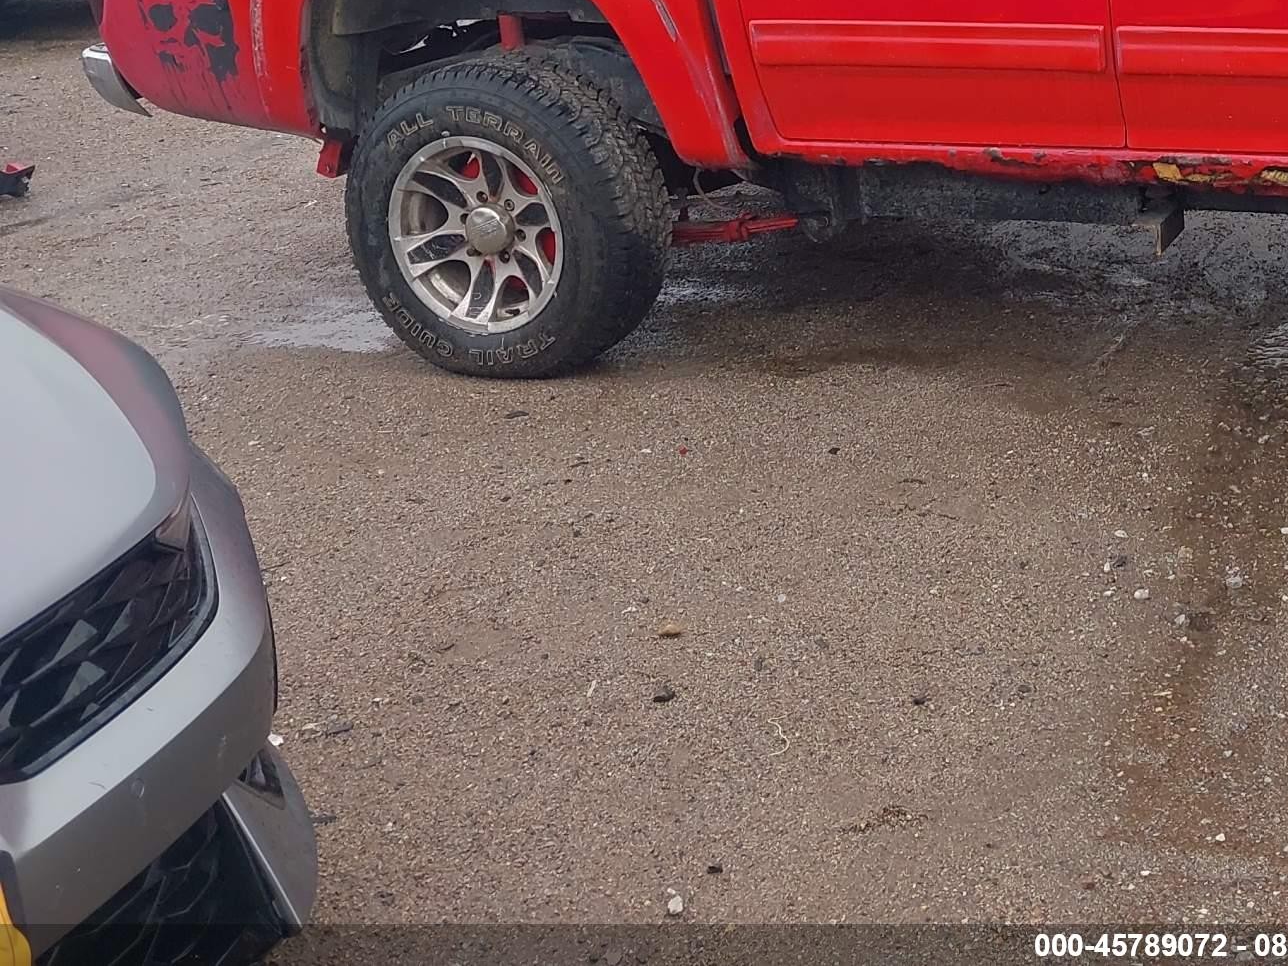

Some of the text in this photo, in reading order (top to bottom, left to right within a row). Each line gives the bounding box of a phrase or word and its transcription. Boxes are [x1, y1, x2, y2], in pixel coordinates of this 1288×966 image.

[387, 106, 562, 184] ALL TERRAIN
[382, 292, 556, 366] TRAIL GUIDE
